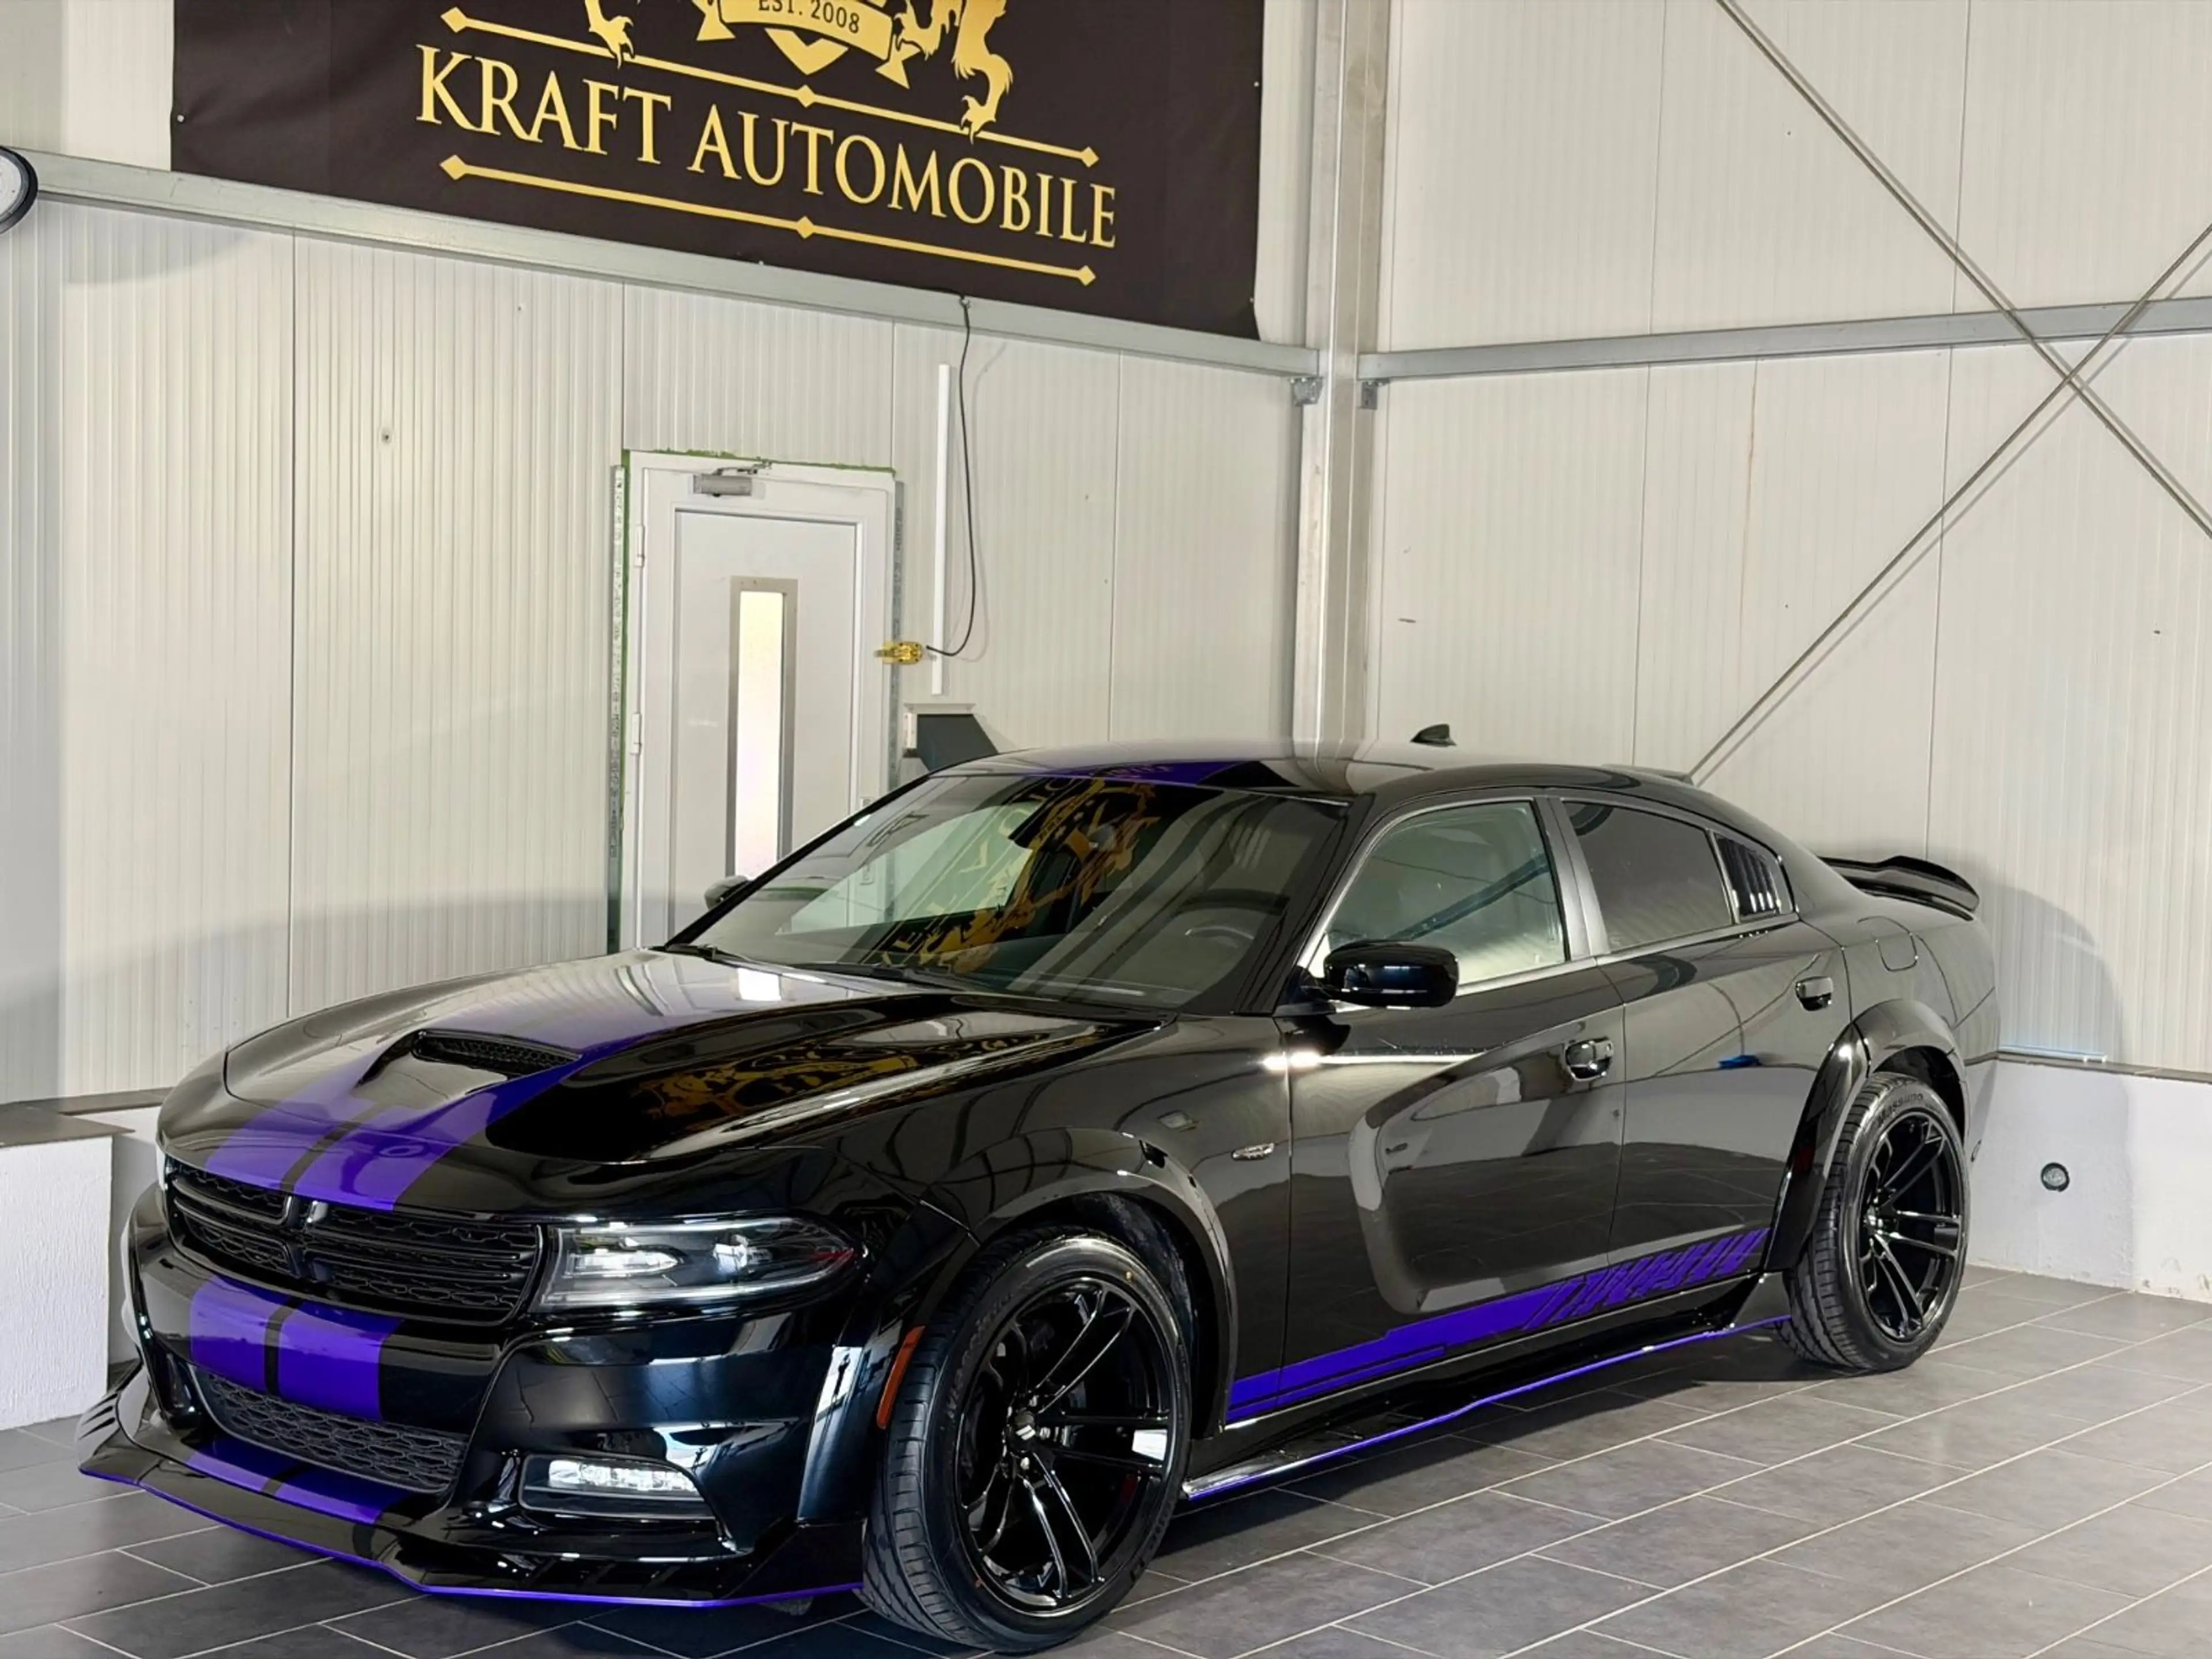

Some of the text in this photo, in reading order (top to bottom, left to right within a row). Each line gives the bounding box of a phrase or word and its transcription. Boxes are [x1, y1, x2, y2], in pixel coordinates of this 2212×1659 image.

[811, 0, 860, 34] 2008
[416, 45, 1116, 248] KRAFT AUTOMOBILE
